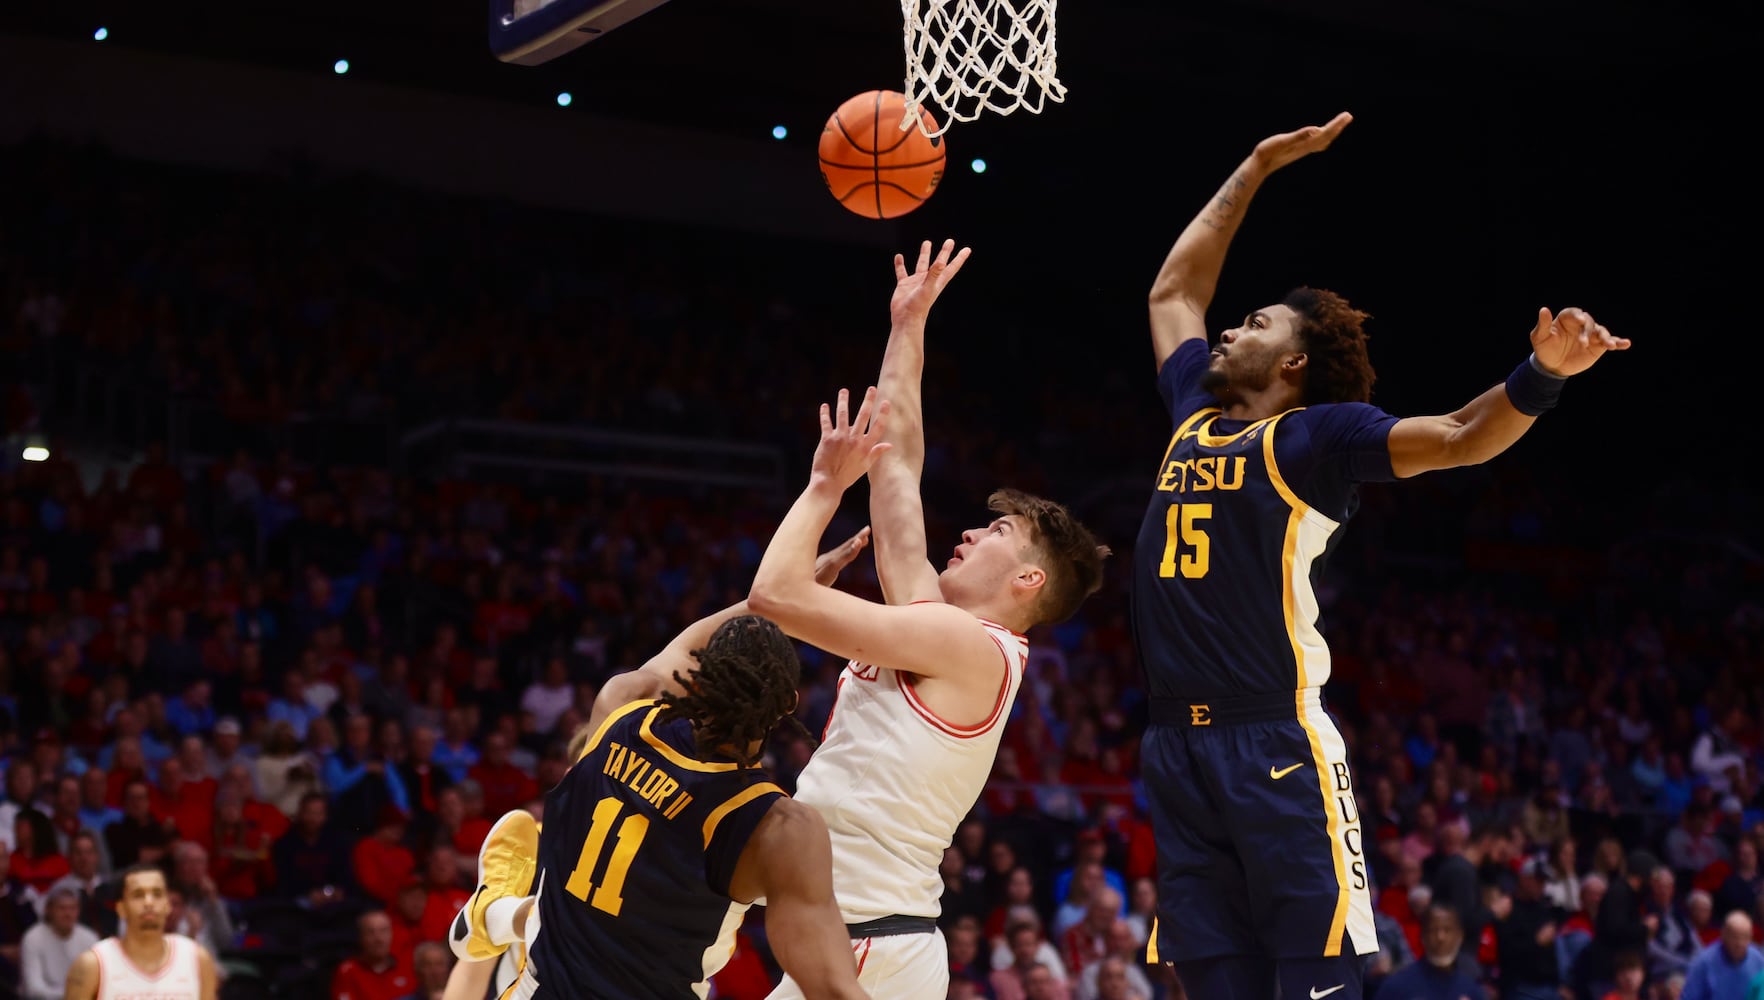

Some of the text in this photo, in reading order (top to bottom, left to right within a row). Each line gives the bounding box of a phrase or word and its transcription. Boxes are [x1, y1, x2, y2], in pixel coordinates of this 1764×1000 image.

[1157, 456, 1247, 493] ETSU
[1158, 503, 1213, 579] 15
[1189, 704, 1211, 726] E
[603, 741, 694, 820] TAYLOR II
[564, 796, 650, 917] 11
[1332, 762, 1366, 890] BUCS
